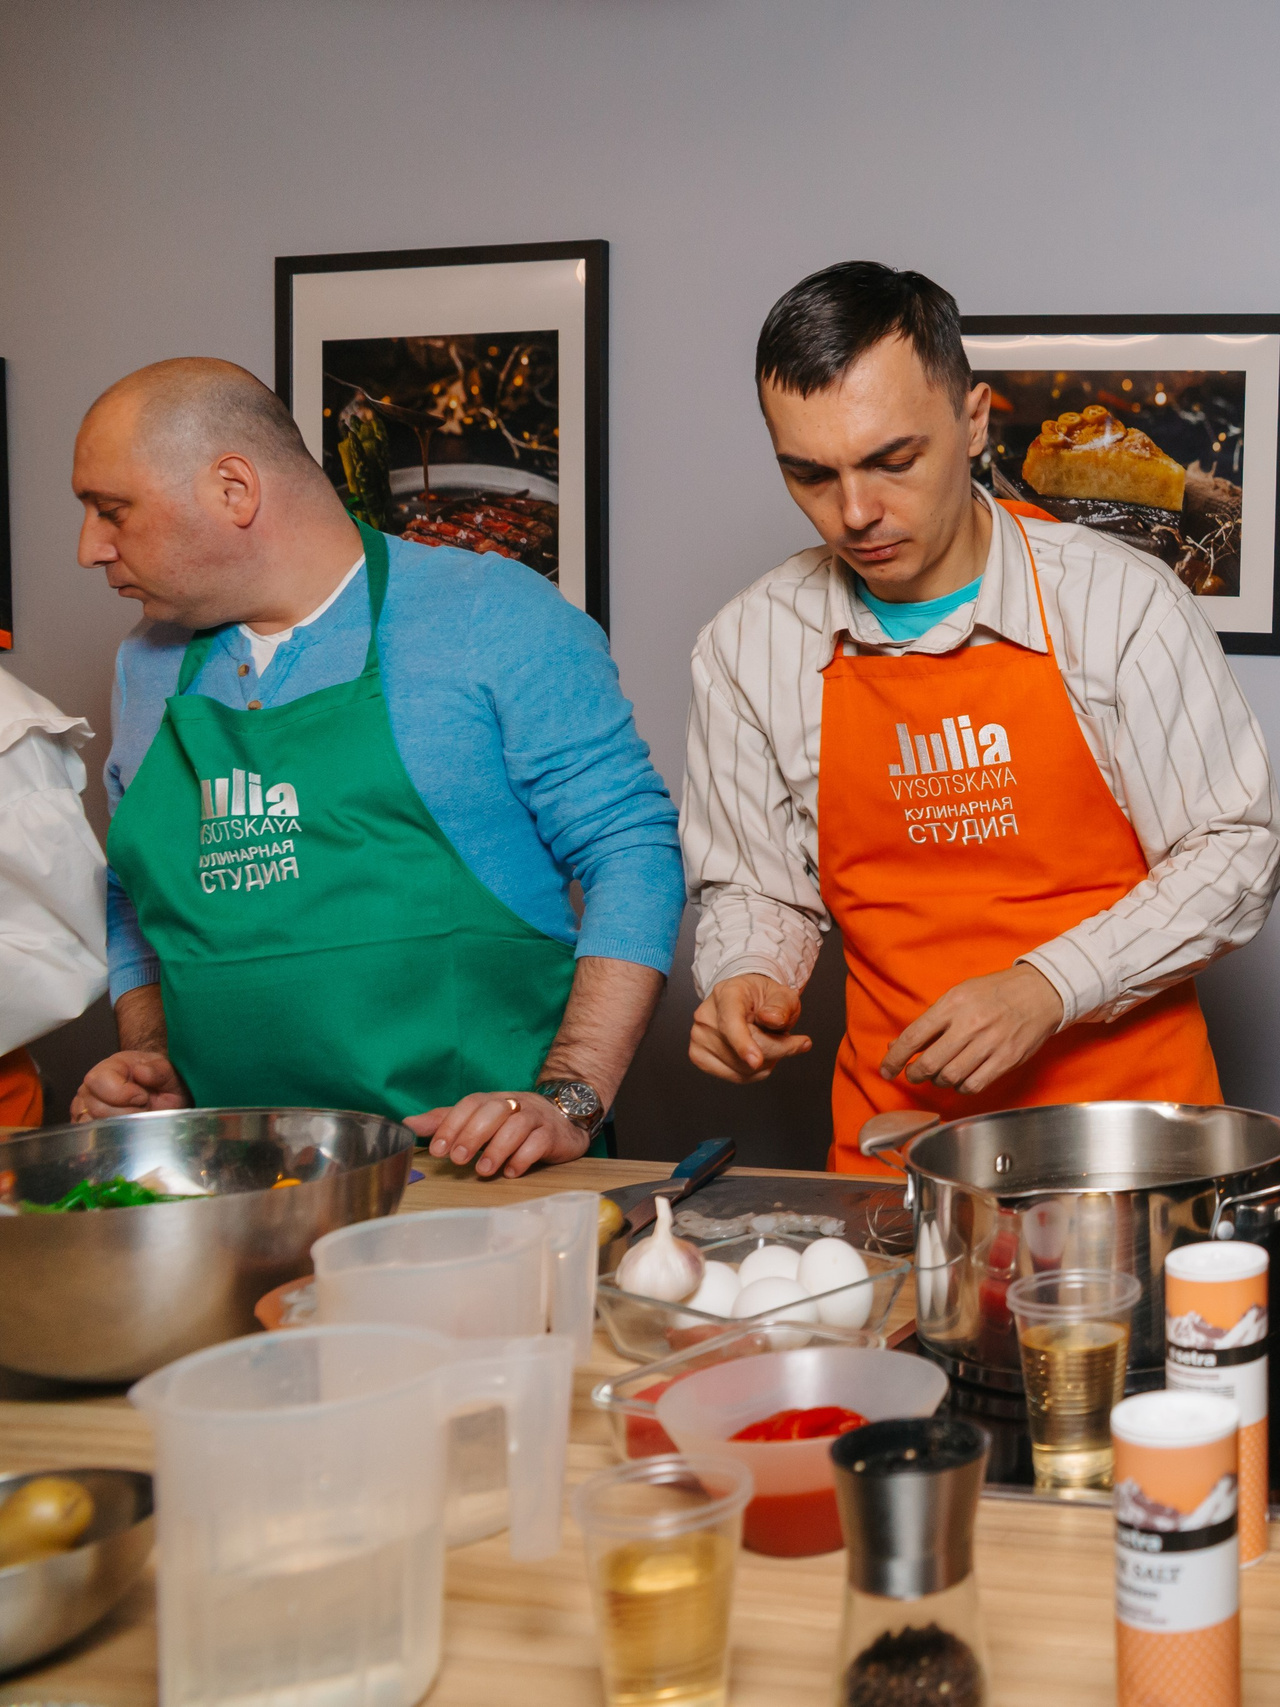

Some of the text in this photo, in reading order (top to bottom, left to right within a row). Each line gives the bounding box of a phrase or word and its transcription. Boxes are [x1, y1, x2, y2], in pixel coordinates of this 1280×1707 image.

[888, 714, 1011, 777] Julia
[201, 768, 300, 820] ulia
[889, 767, 1017, 800] VYSOTSKAYA
[904, 796, 1014, 821] КУЛИНАРНАЯ
[200, 817, 302, 845] SOTSKAYA
[908, 813, 1019, 846] СТУДИЯ
[200, 856, 300, 894] СТУДИЯ
